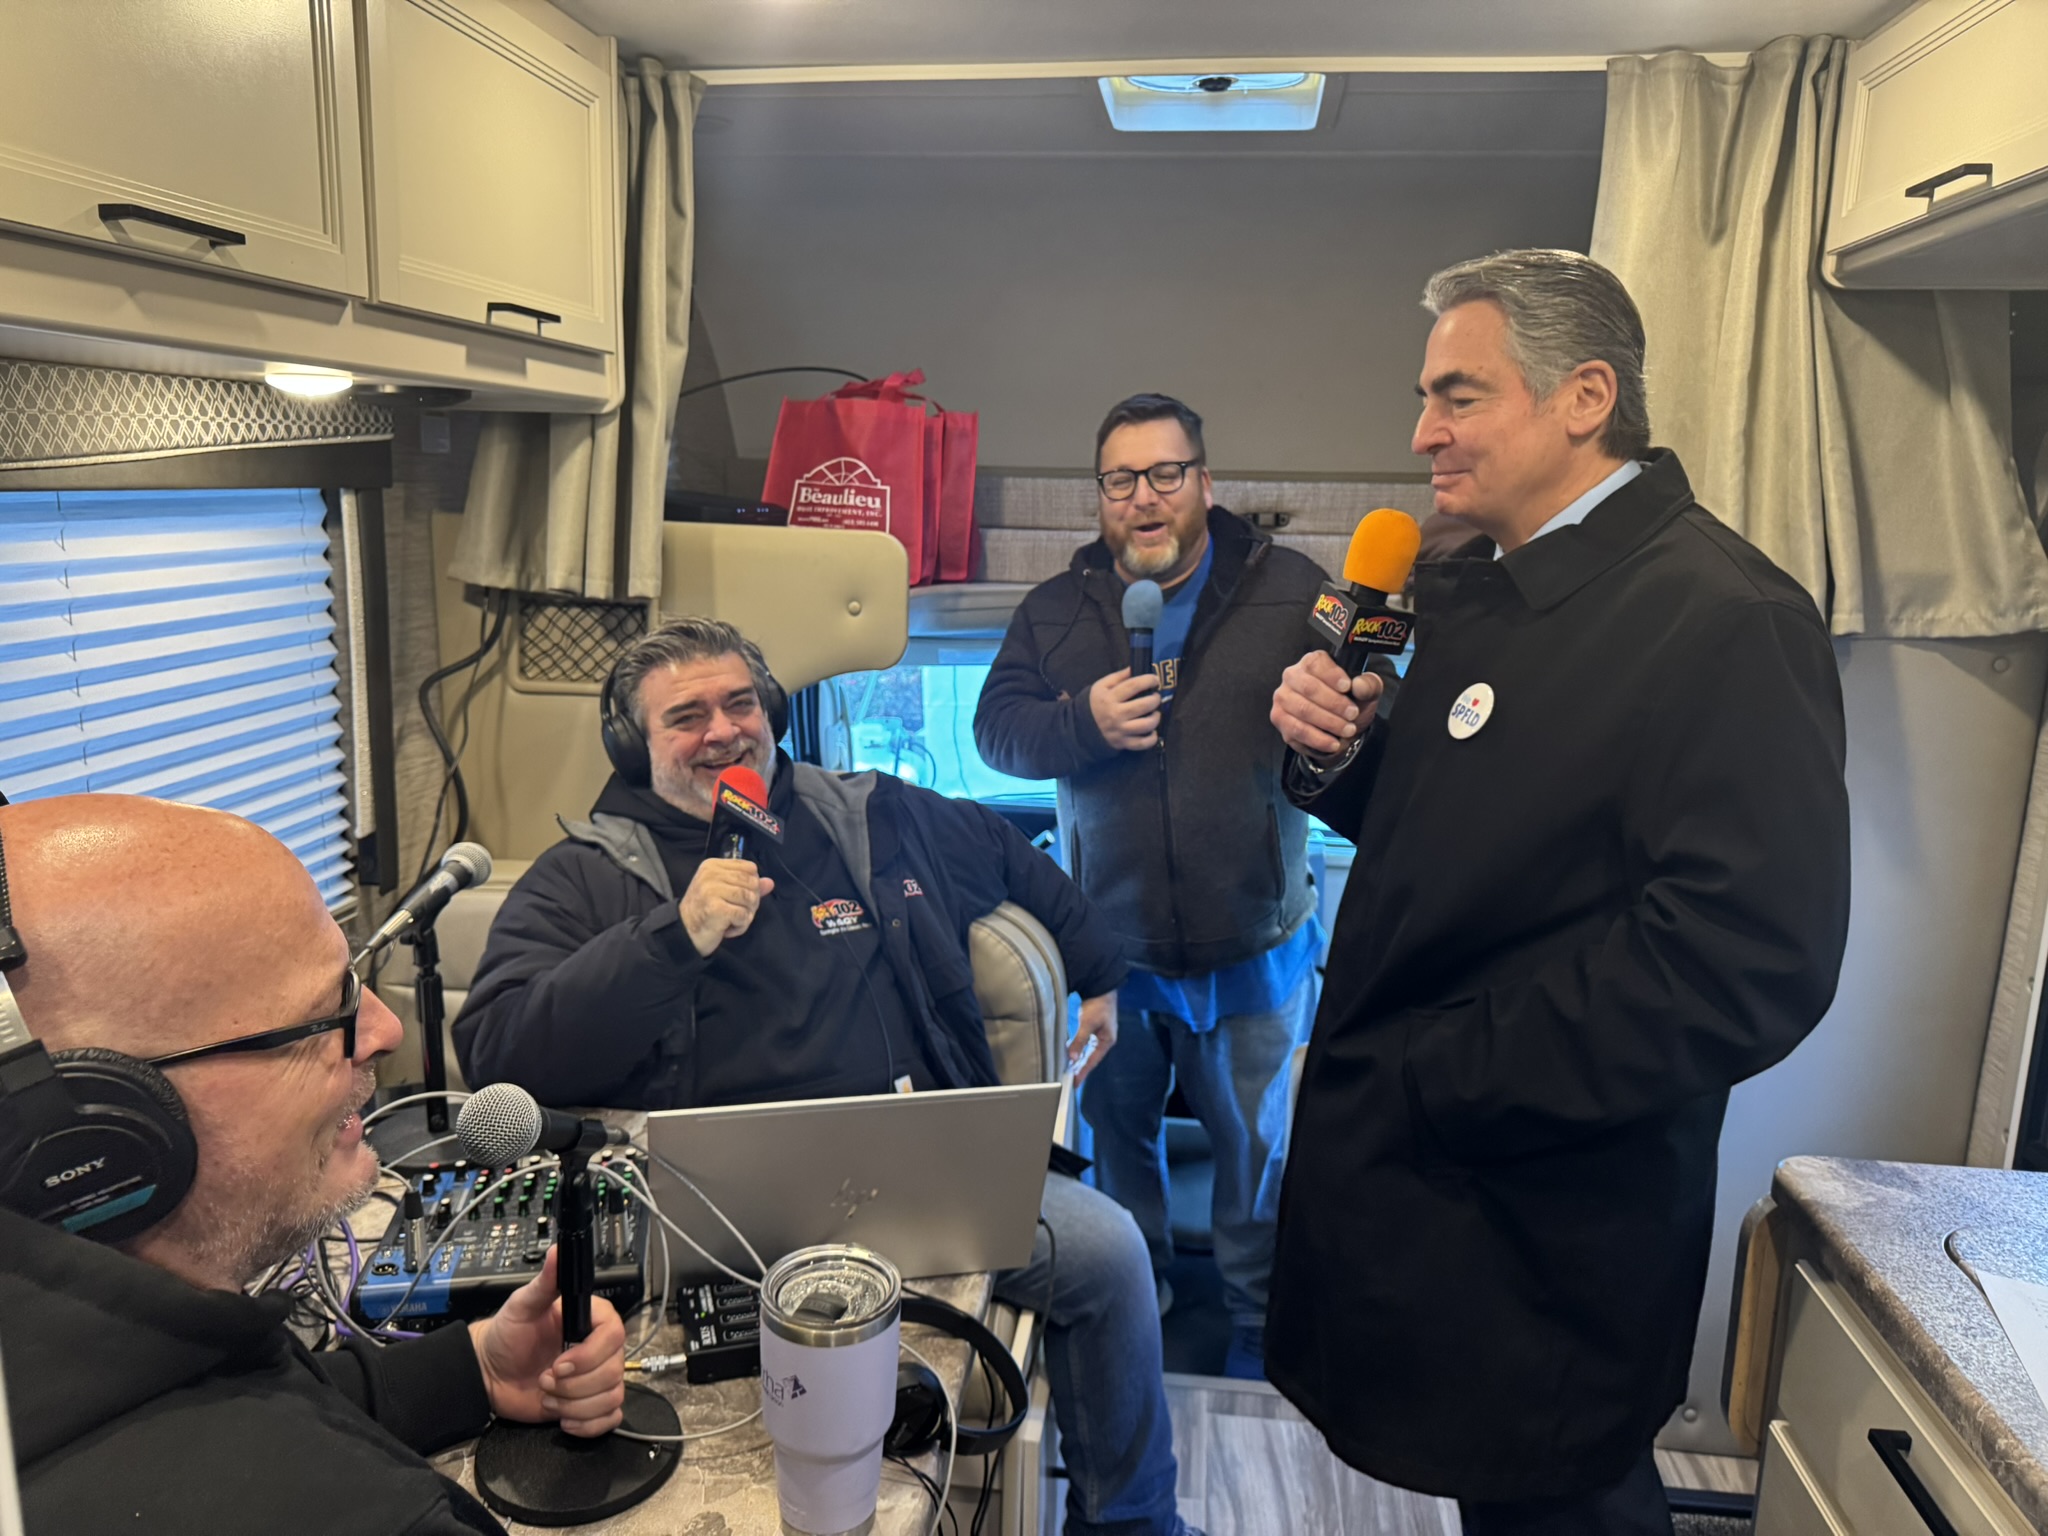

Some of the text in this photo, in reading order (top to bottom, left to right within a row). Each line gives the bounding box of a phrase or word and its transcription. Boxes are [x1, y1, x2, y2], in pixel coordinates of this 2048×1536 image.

[798, 486, 882, 509] Beaulieu
[1451, 703, 1480, 727] SPFLD
[45, 1157, 105, 1188] SONY
[391, 1302, 428, 1313] YMAHA
